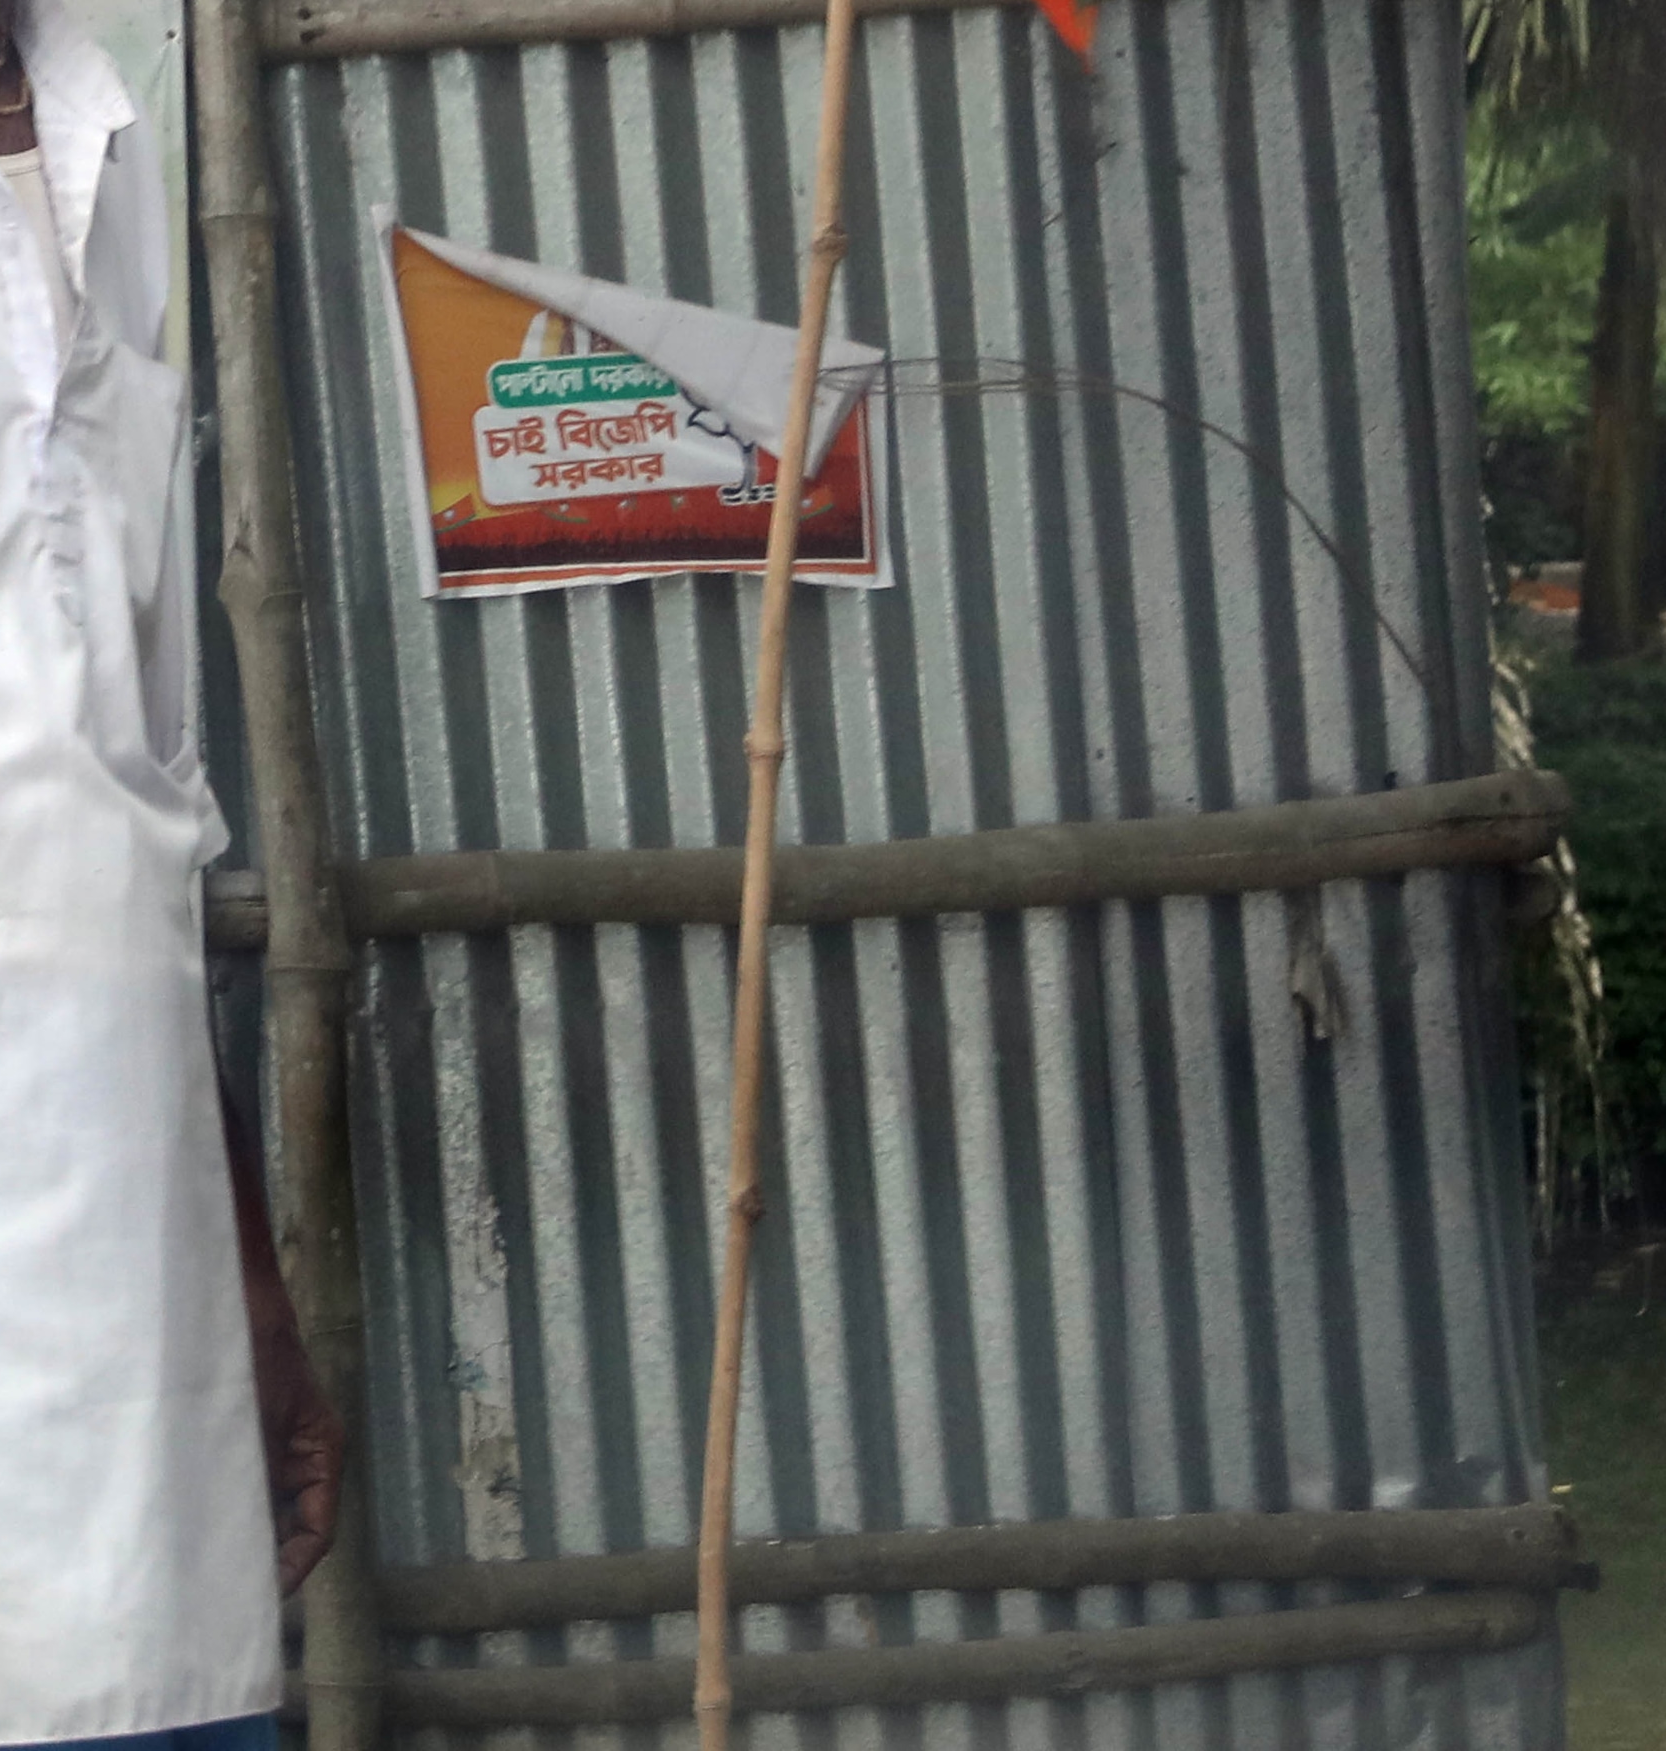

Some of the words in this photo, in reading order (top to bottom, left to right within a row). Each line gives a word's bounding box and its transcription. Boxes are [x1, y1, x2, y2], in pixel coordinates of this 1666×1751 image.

[483, 416, 546, 459] চাই
[556, 401, 678, 451] বিজেপি
[529, 453, 665, 490] সরকার
